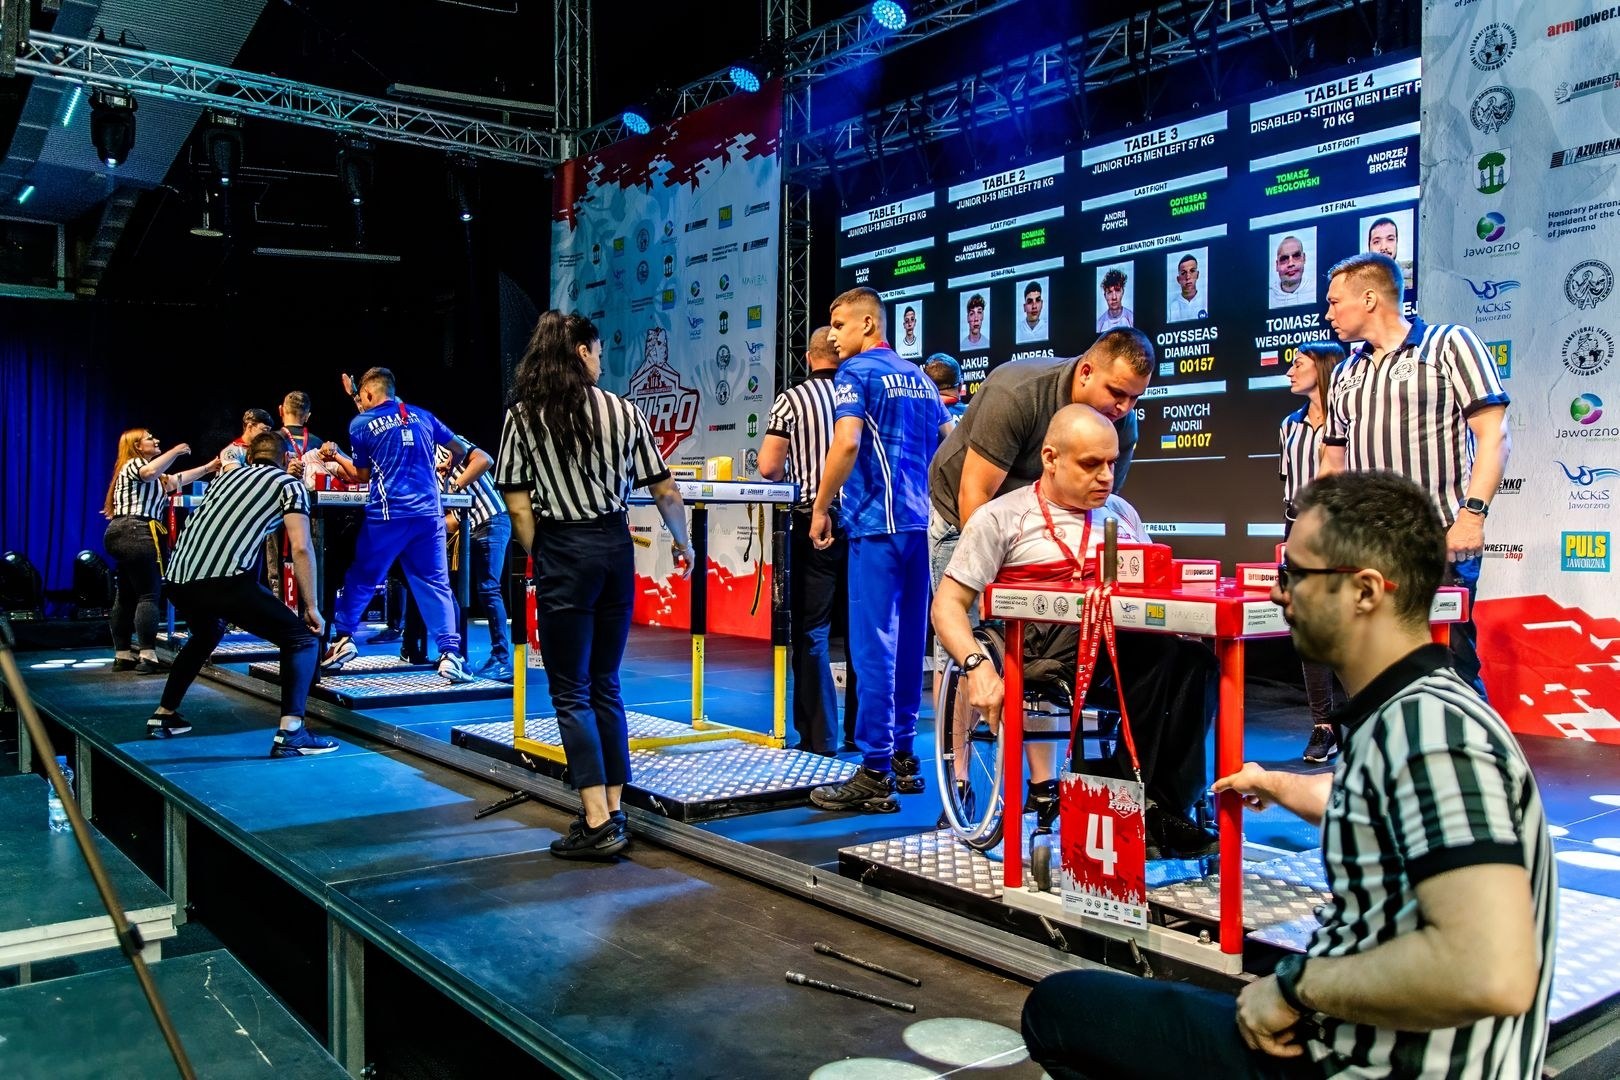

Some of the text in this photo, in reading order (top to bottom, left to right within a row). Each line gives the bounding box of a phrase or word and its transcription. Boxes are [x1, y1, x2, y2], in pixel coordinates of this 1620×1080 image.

[1304, 72, 1375, 104] TABLE 4
[1573, 72, 1620, 92] ARMWRESTL
[1250, 111, 1302, 134] DISABLED
[1309, 98, 1353, 118] SITTING
[1354, 90, 1380, 108] MEN
[1383, 82, 1415, 100] LEFT
[1322, 111, 1355, 129] 70 KG
[1124, 127, 1178, 153] TABLE 3
[1317, 137, 1361, 154] LAST FIGHT
[1092, 134, 1215, 175] JUNIOR U-15 MEN LEFT 57 KG
[1366, 146, 1409, 165] ANDRZEJ
[1369, 156, 1407, 175] BROŻEK
[982, 169, 1026, 191] TABLE 2
[1275, 168, 1310, 183] TOMASZ
[956, 196, 981, 210] JUNIOR
[982, 192, 997, 203] U-15
[998, 188, 1013, 200] MEN
[1013, 182, 1032, 195] LEFT
[1042, 176, 1054, 188] KG
[1264, 176, 1321, 197] WESOŁOWSKI
[1169, 192, 1208, 207] ODYSSEAS
[1320, 199, 1357, 214] 1ST FINAL
[868, 202, 903, 221] TABLE 1
[1103, 210, 1126, 222] ANDRII
[1172, 201, 1206, 216] DIAMANTI
[1547, 205, 1587, 220] Honorary
[847, 226, 868, 238] JUNIOR
[881, 219, 894, 230] MEN
[894, 214, 908, 226] LEFT
[917, 210, 927, 220] KG
[1101, 218, 1128, 231] PONYCH
[1547, 209, 1616, 229] President of the
[1547, 224, 1596, 239] of Jaworzno
[962, 241, 987, 253] ANDREAS
[1119, 240, 1156, 253] ELIMINATION
[1165, 234, 1182, 244] FINAL
[1463, 241, 1521, 259] Jaworzno
[1265, 313, 1320, 333] TOMASZ
[1475, 313, 1512, 324] Jaworzno
[1157, 326, 1218, 345] ODYSSEAS
[1255, 329, 1331, 348] WESOŁOWSKI
[1164, 343, 1210, 359] DIAMANTI
[960, 356, 989, 370] JAKUB
[1179, 357, 1215, 373] 00157
[963, 370, 986, 381] MIRKA
[631, 394, 700, 434] URO
[1163, 403, 1211, 419] PONYCH
[1170, 419, 1202, 432] ANDRII
[1555, 426, 1620, 440] Jaworzno
[1177, 433, 1212, 448] 00107
[1568, 489, 1611, 501] MCKiS
[1568, 501, 1611, 510] Jaworzno
[1149, 524, 1177, 532] RESULTS
[1483, 543, 1524, 553] WRESTLING
[1565, 534, 1606, 558] PULS
[1504, 551, 1524, 562] shop
[1566, 559, 1606, 569] JAWORZNA
[288, 577, 294, 601] 2
[1085, 813, 1118, 876] 4
